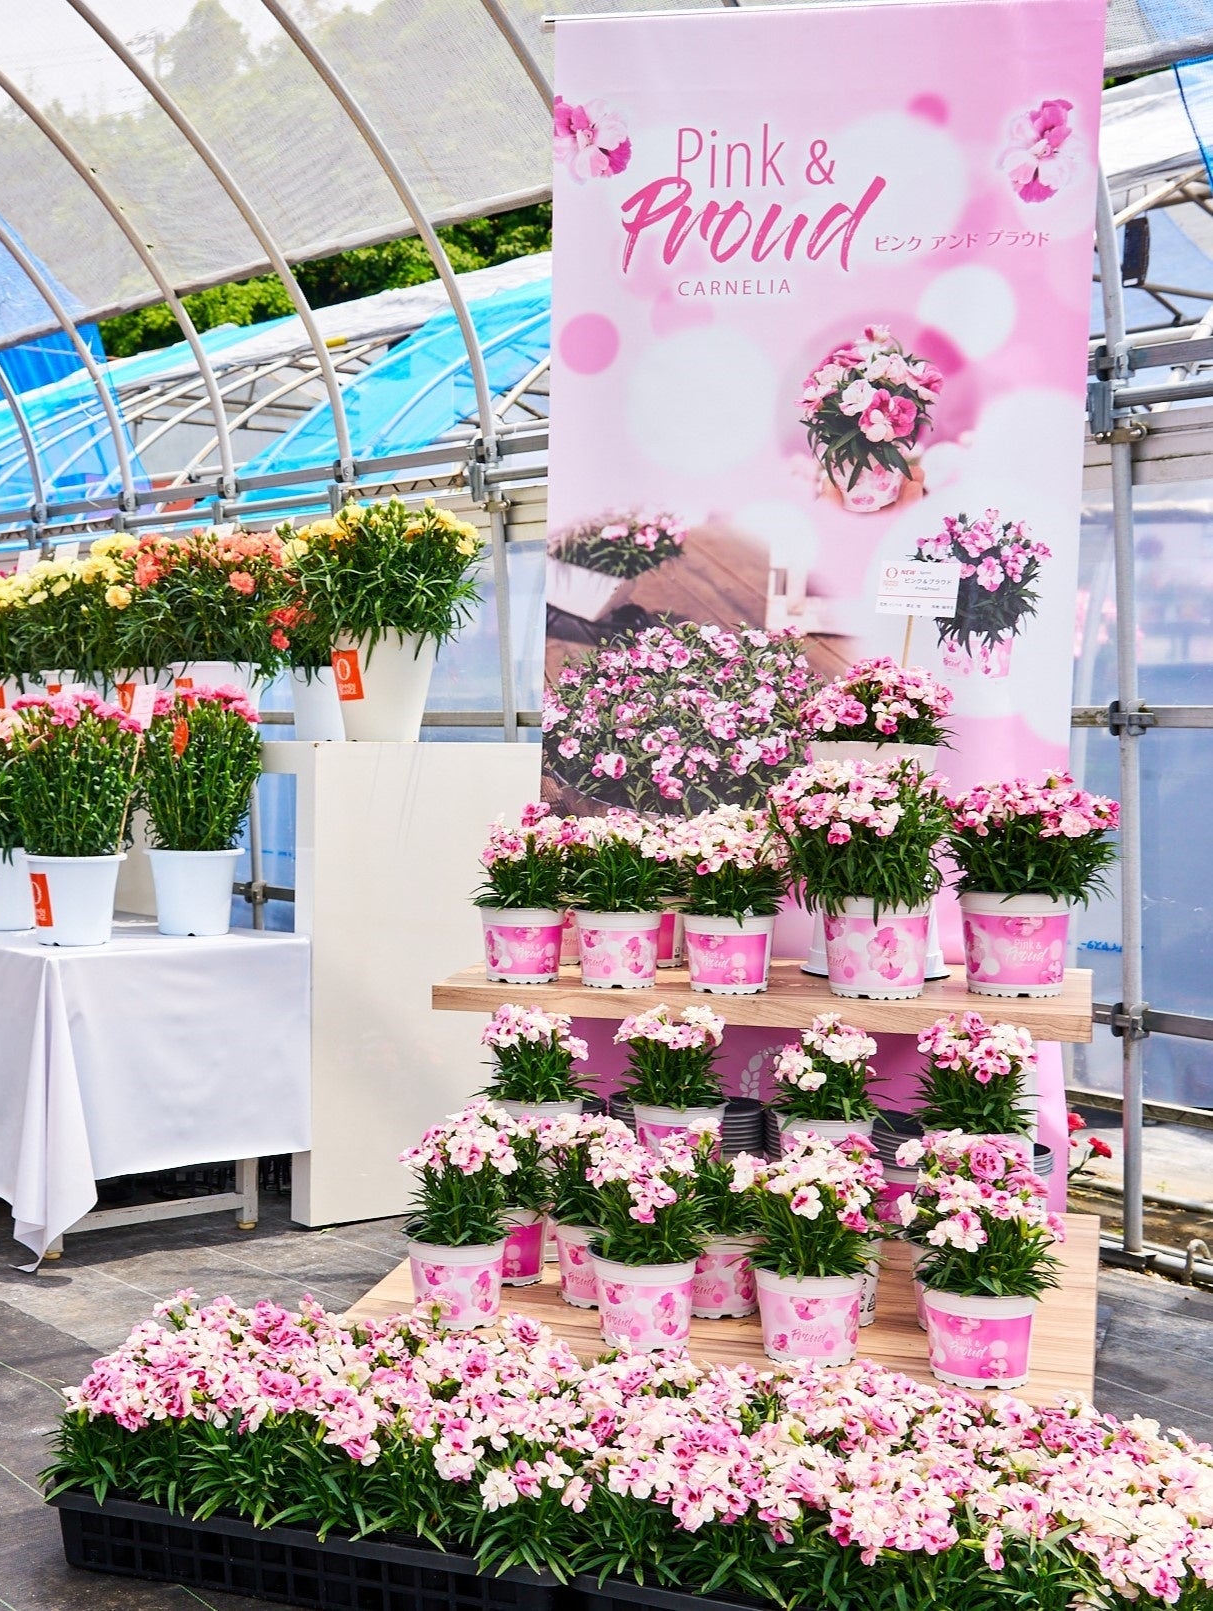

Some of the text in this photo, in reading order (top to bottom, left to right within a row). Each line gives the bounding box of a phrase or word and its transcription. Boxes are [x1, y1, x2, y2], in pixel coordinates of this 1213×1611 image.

[676, 123, 836, 188] Pink &
[620, 175, 887, 274] Proud
[874, 235, 922, 252] ピンク
[930, 233, 979, 250] アンド
[677, 278, 792, 297] CARNELIA
